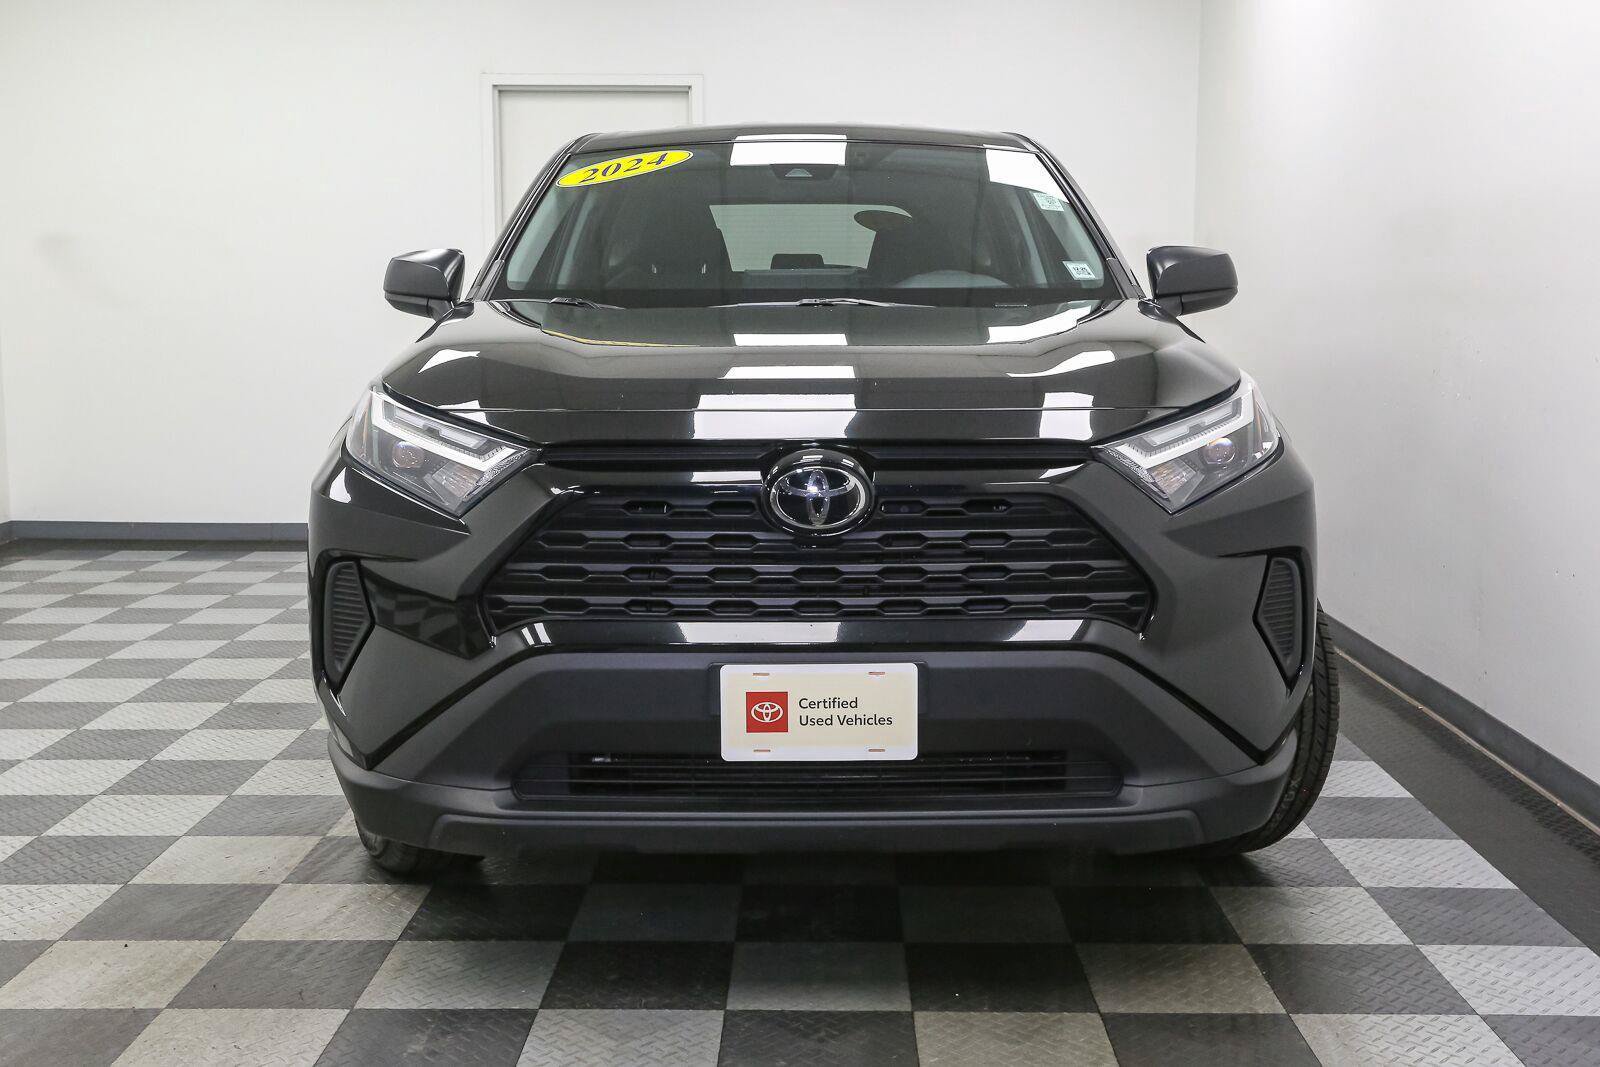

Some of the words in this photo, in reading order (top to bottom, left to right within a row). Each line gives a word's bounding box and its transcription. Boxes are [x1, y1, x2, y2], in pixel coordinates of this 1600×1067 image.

[579, 152, 668, 184] 2024
[799, 697, 859, 710] Certified
[799, 715, 834, 727] Used
[837, 714, 893, 727] Vehicles
